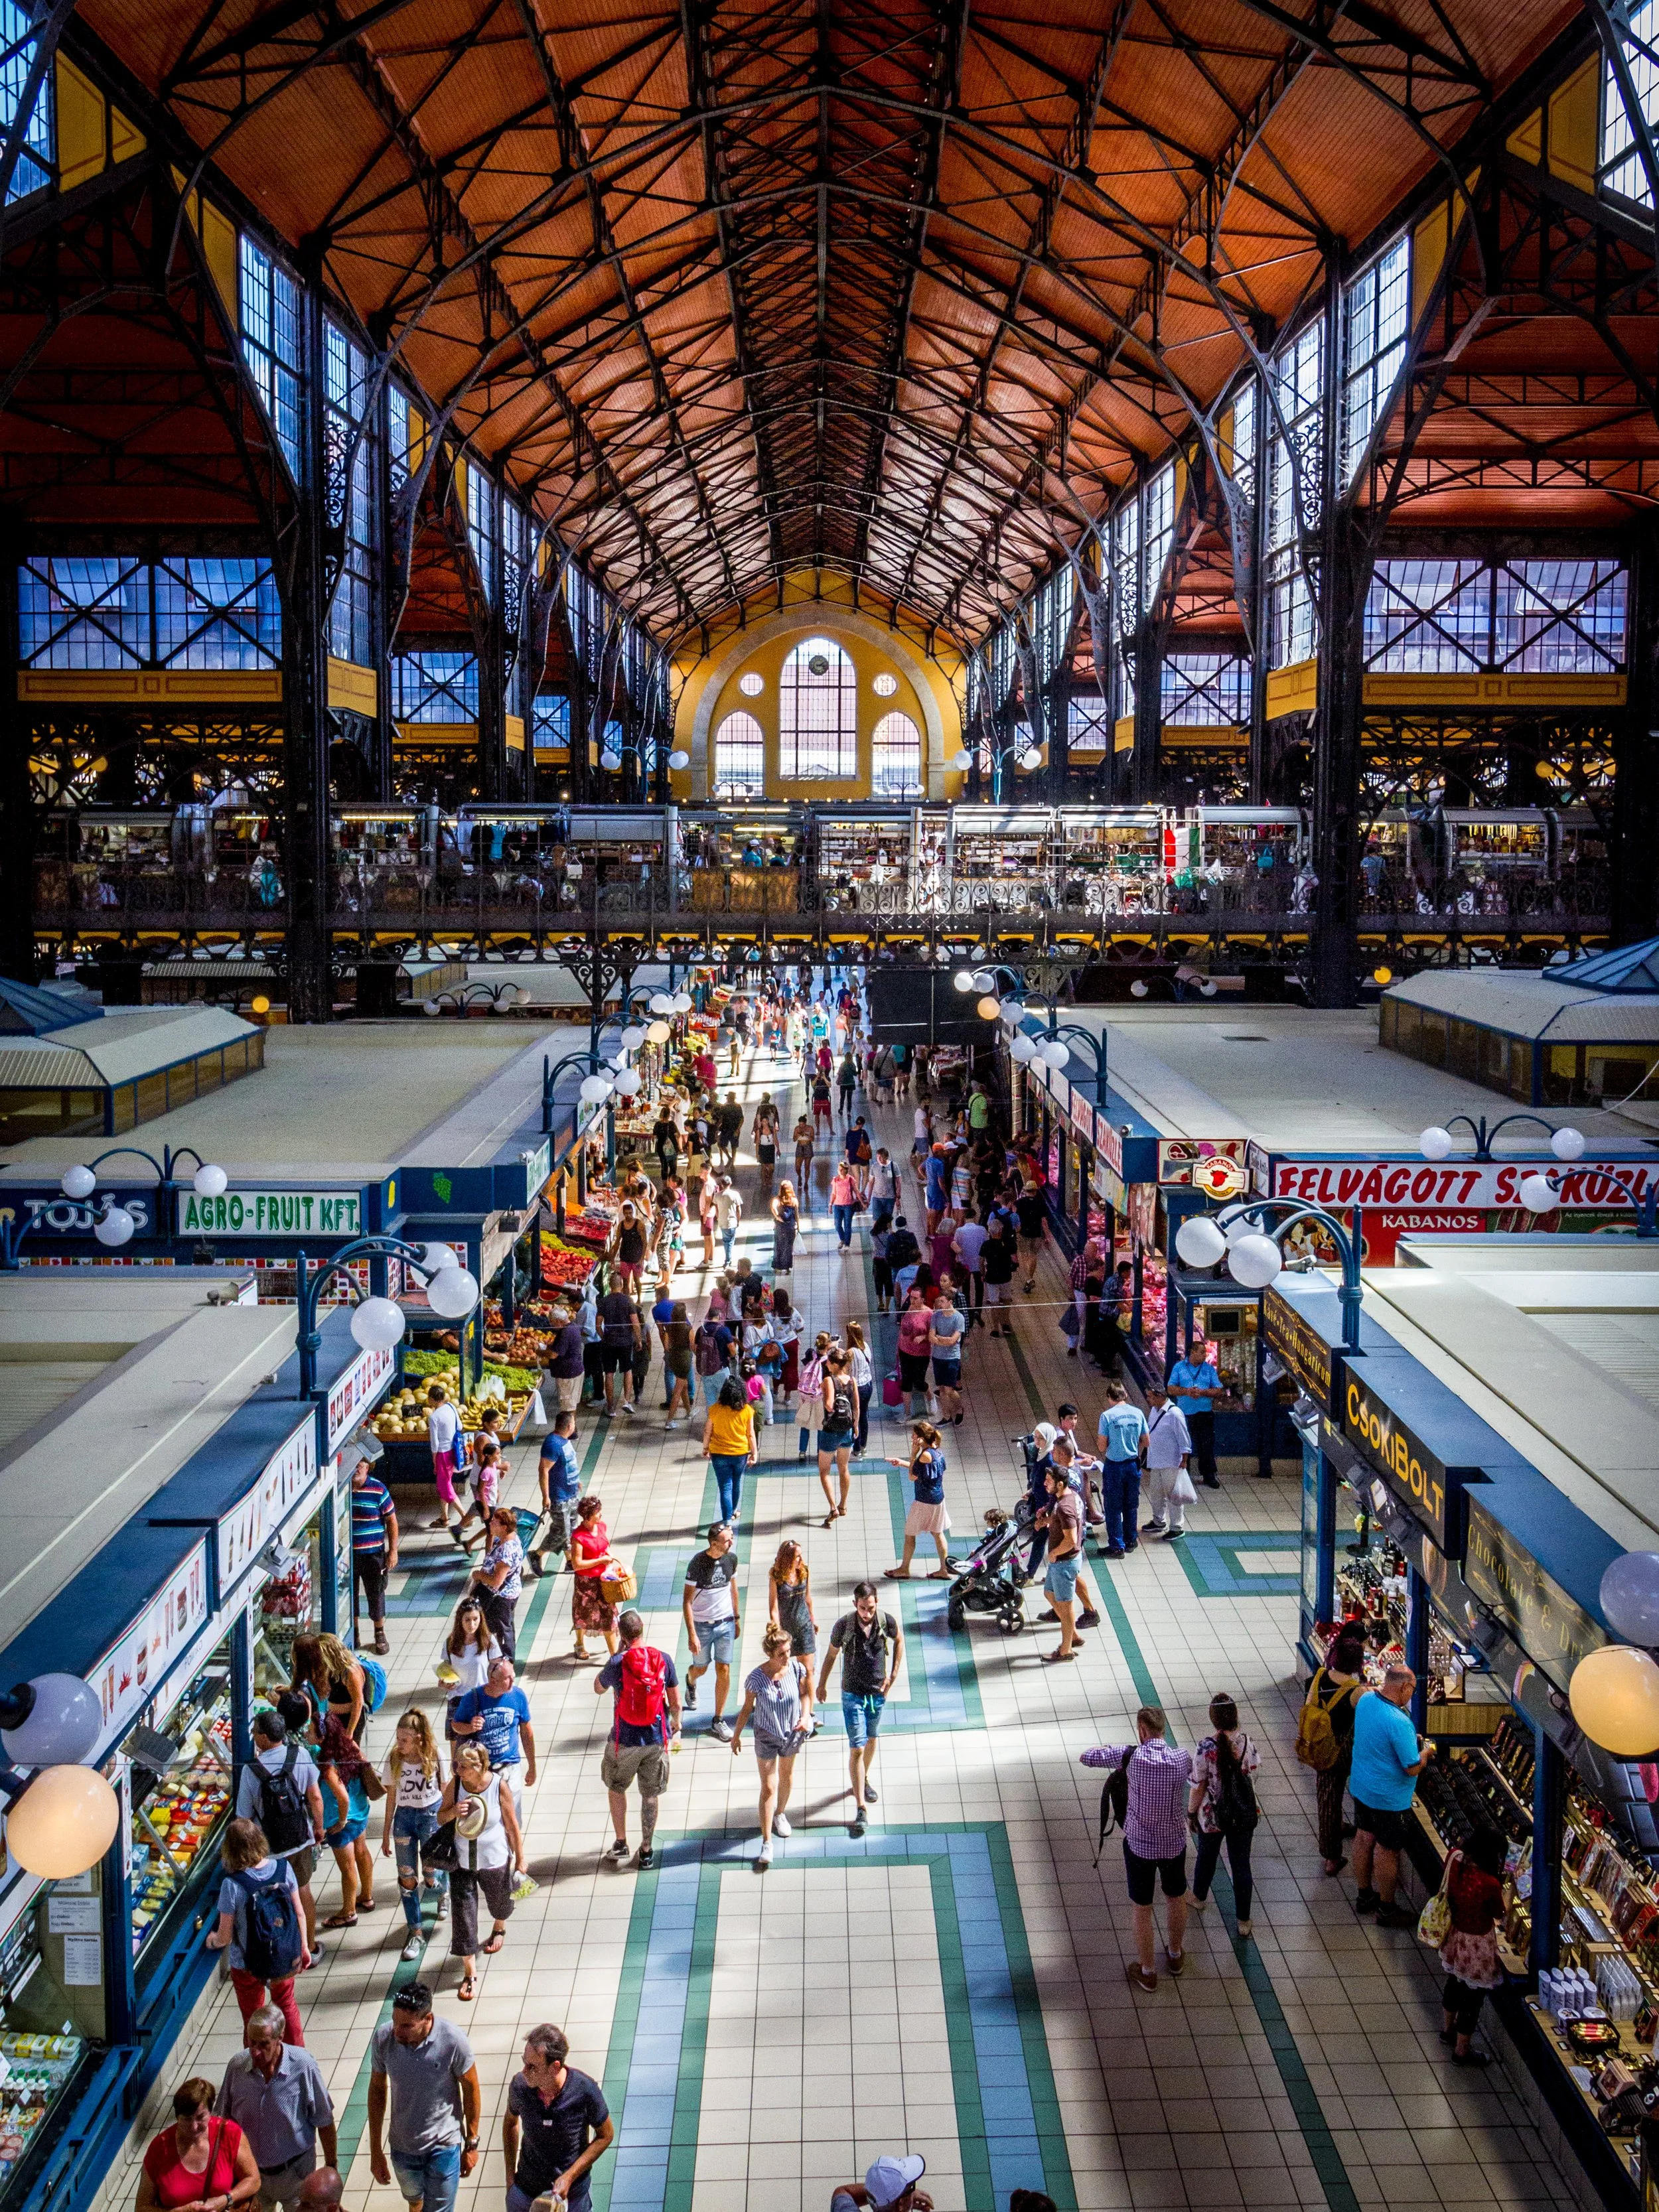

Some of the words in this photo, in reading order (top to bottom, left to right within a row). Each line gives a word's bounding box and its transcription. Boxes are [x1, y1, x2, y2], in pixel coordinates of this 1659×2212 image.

[1206, 1160, 1234, 1171] KABANOS
[1279, 1164, 1482, 1204] FELVÁGOTT
[1494, 1164, 1659, 1204] SKÜZL
[184, 1195, 315, 1231] AGRO-FRUIT
[319, 1198, 360, 1231] KFT.
[1382, 1214, 1479, 1229] KABANOS
[1293, 1330, 1331, 1388] Hungaricum
[1467, 1524, 1534, 1616] Chocolate
[1560, 1622, 1584, 1663] Dri
[401, 1778, 432, 1793] OVE
